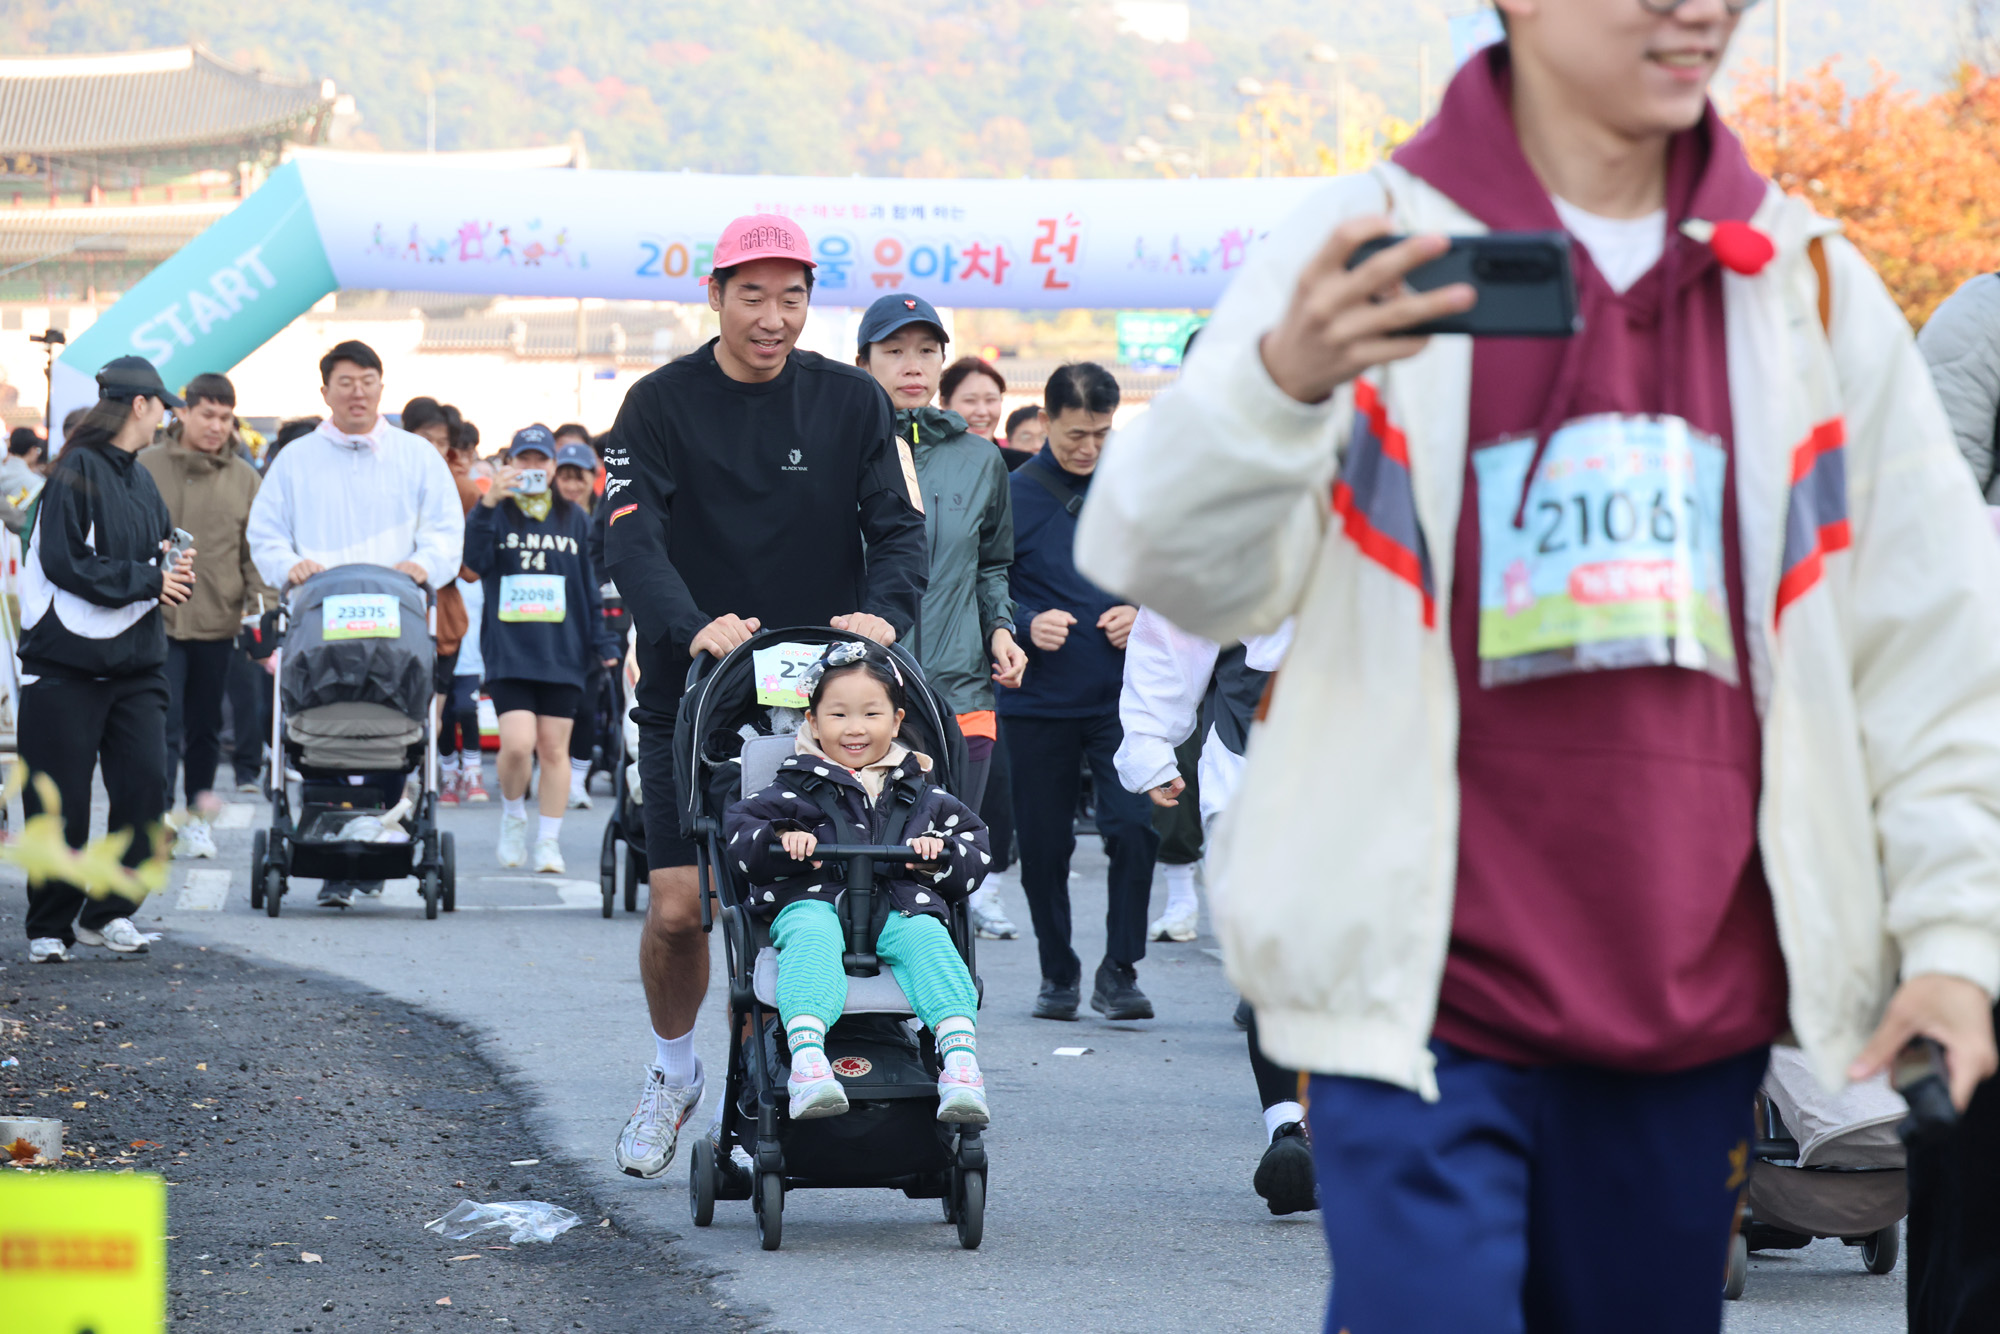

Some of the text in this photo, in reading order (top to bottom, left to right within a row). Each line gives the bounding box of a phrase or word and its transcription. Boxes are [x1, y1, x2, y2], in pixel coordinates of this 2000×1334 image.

[740, 226, 795, 251] HAPPIER
[871, 238, 1011, 289] 유아차
[1031, 217, 1080, 290] 런
[130, 245, 277, 369] START
[519, 550, 547, 571] 74
[510, 588, 555, 602] 22098
[337, 606, 386, 619] 23375
